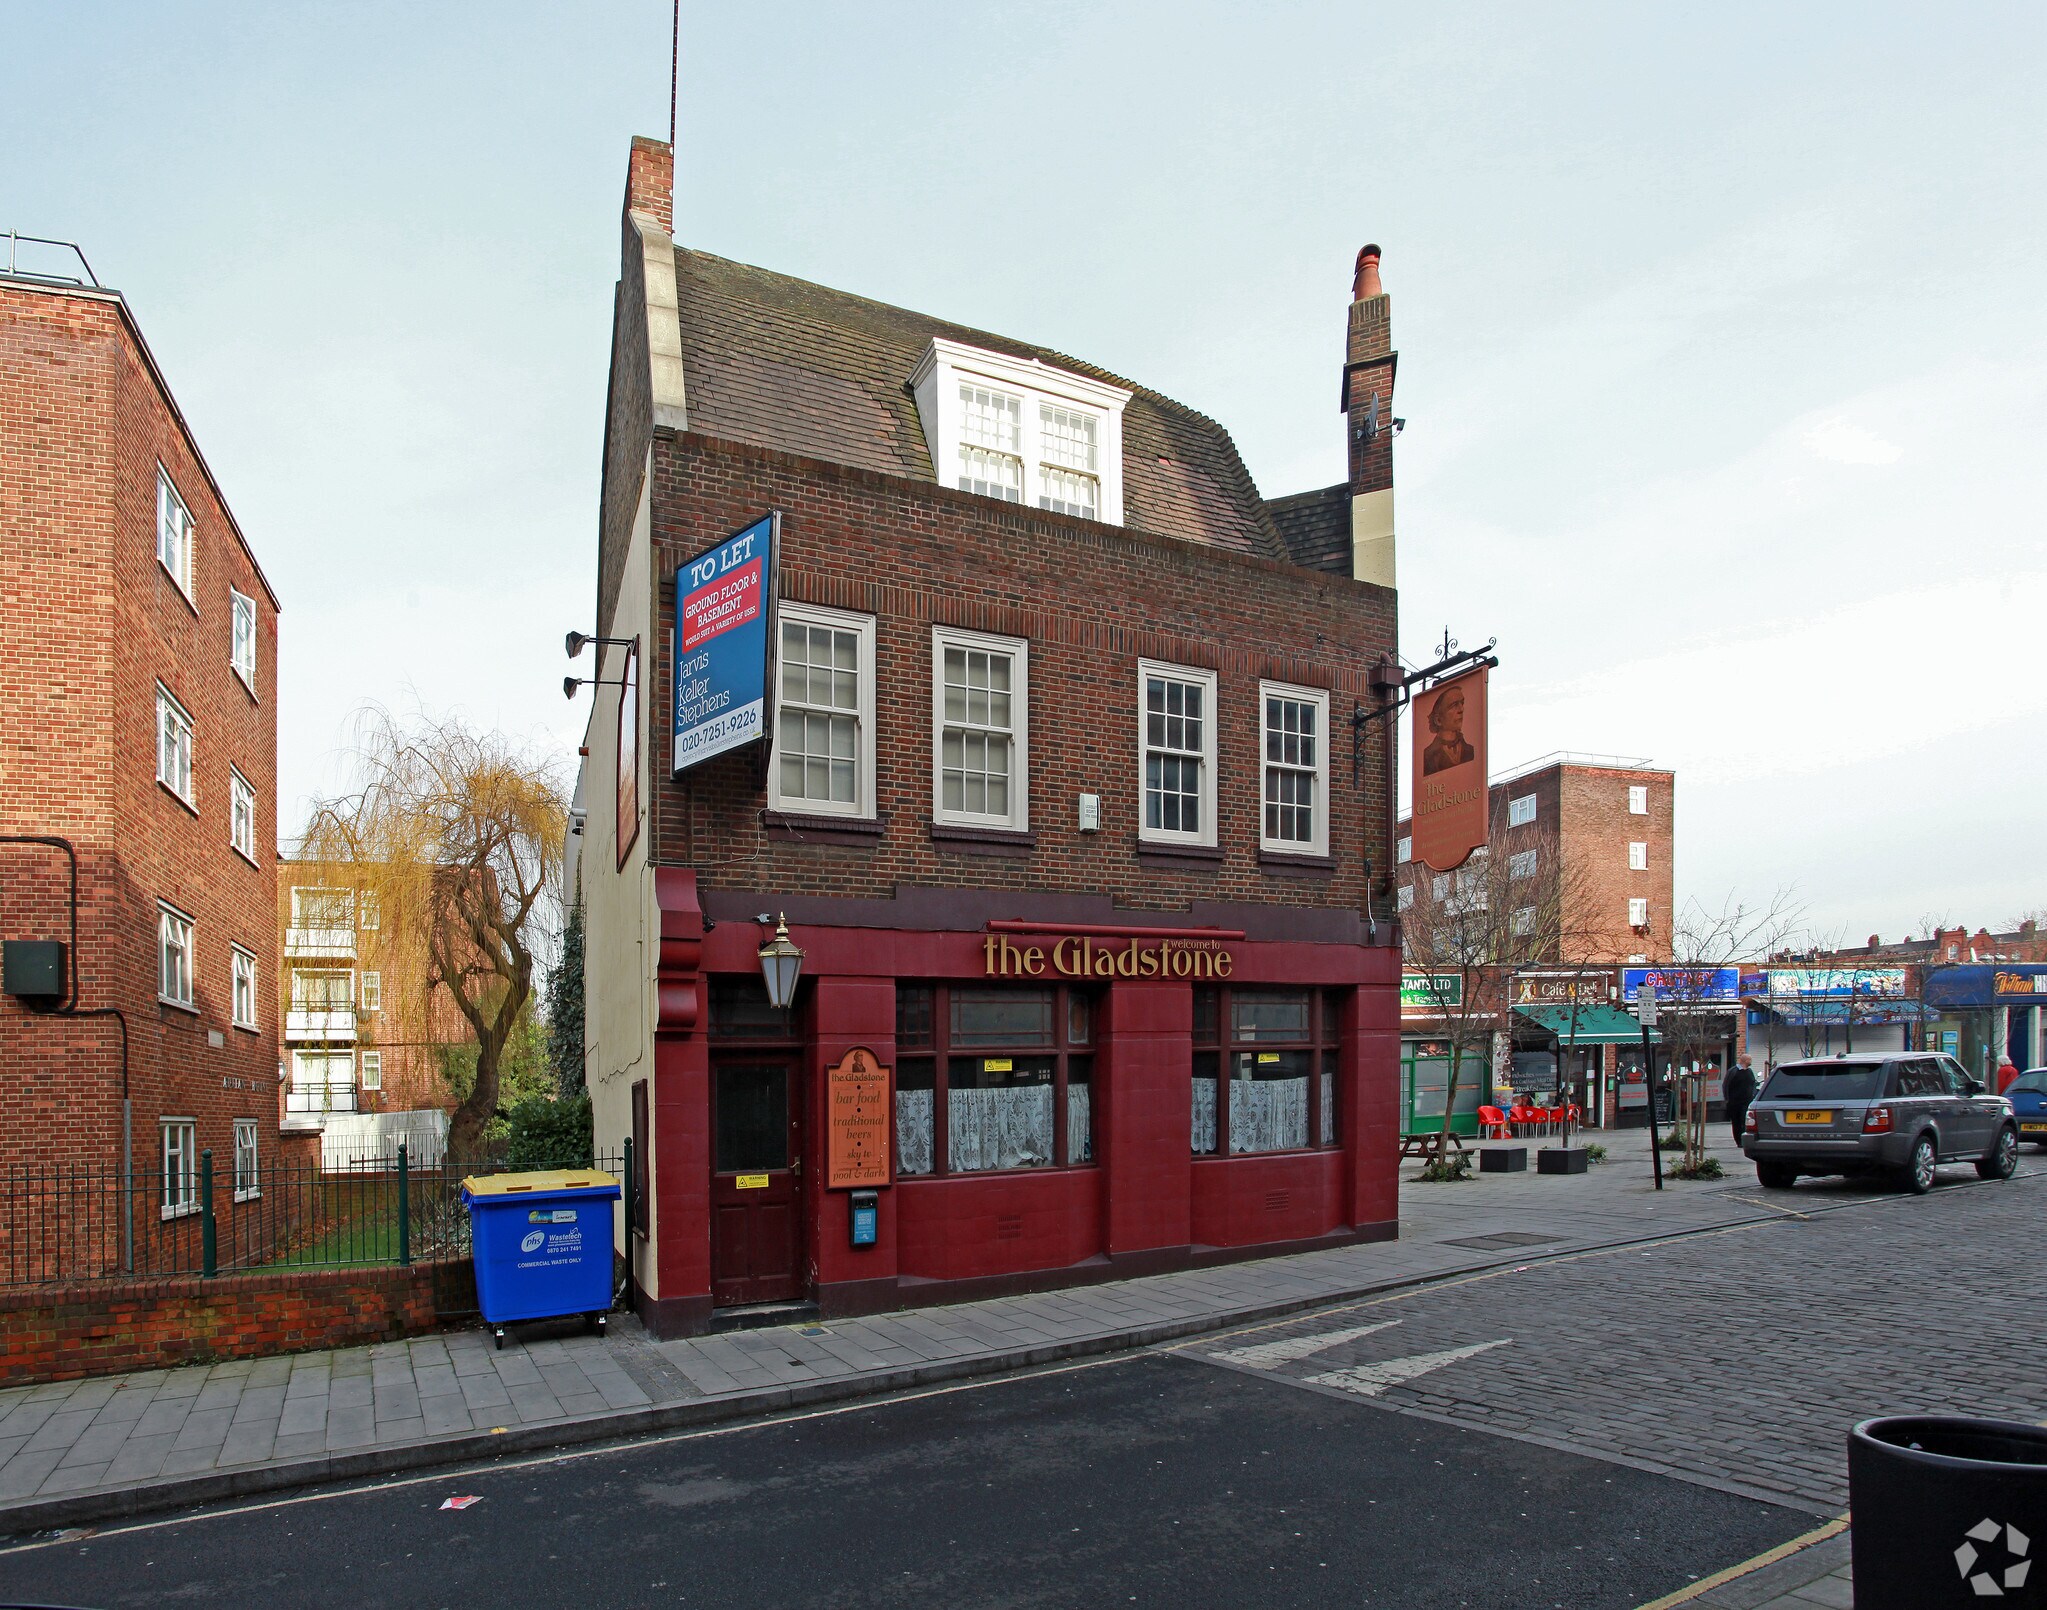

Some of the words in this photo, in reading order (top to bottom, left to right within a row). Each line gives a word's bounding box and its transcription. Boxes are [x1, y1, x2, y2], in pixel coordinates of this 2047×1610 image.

[691, 557, 716, 588] TO
[720, 533, 755, 573] LET
[685, 591, 719, 619] GROUND
[720, 575, 749, 600] FLOOR
[751, 571, 758, 585] &
[697, 595, 742, 628] BASEMENT
[685, 633, 701, 647] WOULD
[700, 627, 711, 638] SUIT
[710, 625, 715, 633] A
[715, 615, 736, 631] VARIETY
[736, 612, 744, 621] OF
[744, 605, 756, 617] USES
[678, 649, 709, 687] Jarvis
[678, 677, 710, 708] Keller
[677, 689, 730, 727] Stephens
[682, 708, 757, 753] 020-7251-9226
[1426, 783, 1446, 798] the
[1416, 787, 1481, 816] Gladstone
[1170, 938, 1211, 950] welcome
[1211, 939, 1220, 950] to
[983, 933, 1046, 975] the
[1053, 936, 1233, 978] Gladstone
[1434, 979, 1451, 990] LTD
[1541, 981, 1566, 997] Café
[1568, 982, 1576, 997] &
[831, 1073, 844, 1082] the
[845, 1073, 886, 1082] Gladstone
[835, 1091, 855, 1105] bar
[855, 1090, 881, 1106] food
[833, 1113, 885, 1127] traditional
[846, 1127, 872, 1140] beers
[847, 1148, 861, 1160] sky
[863, 1149, 872, 1158] tv
[833, 1168, 852, 1182] pool
[854, 1168, 862, 1179] &
[863, 1167, 886, 1179] darts
[526, 1236, 541, 1248] phs
[549, 1232, 582, 1241] Wastetech
[517, 1260, 550, 1269] COMMERCIAL
[551, 1258, 568, 1266] WASTE
